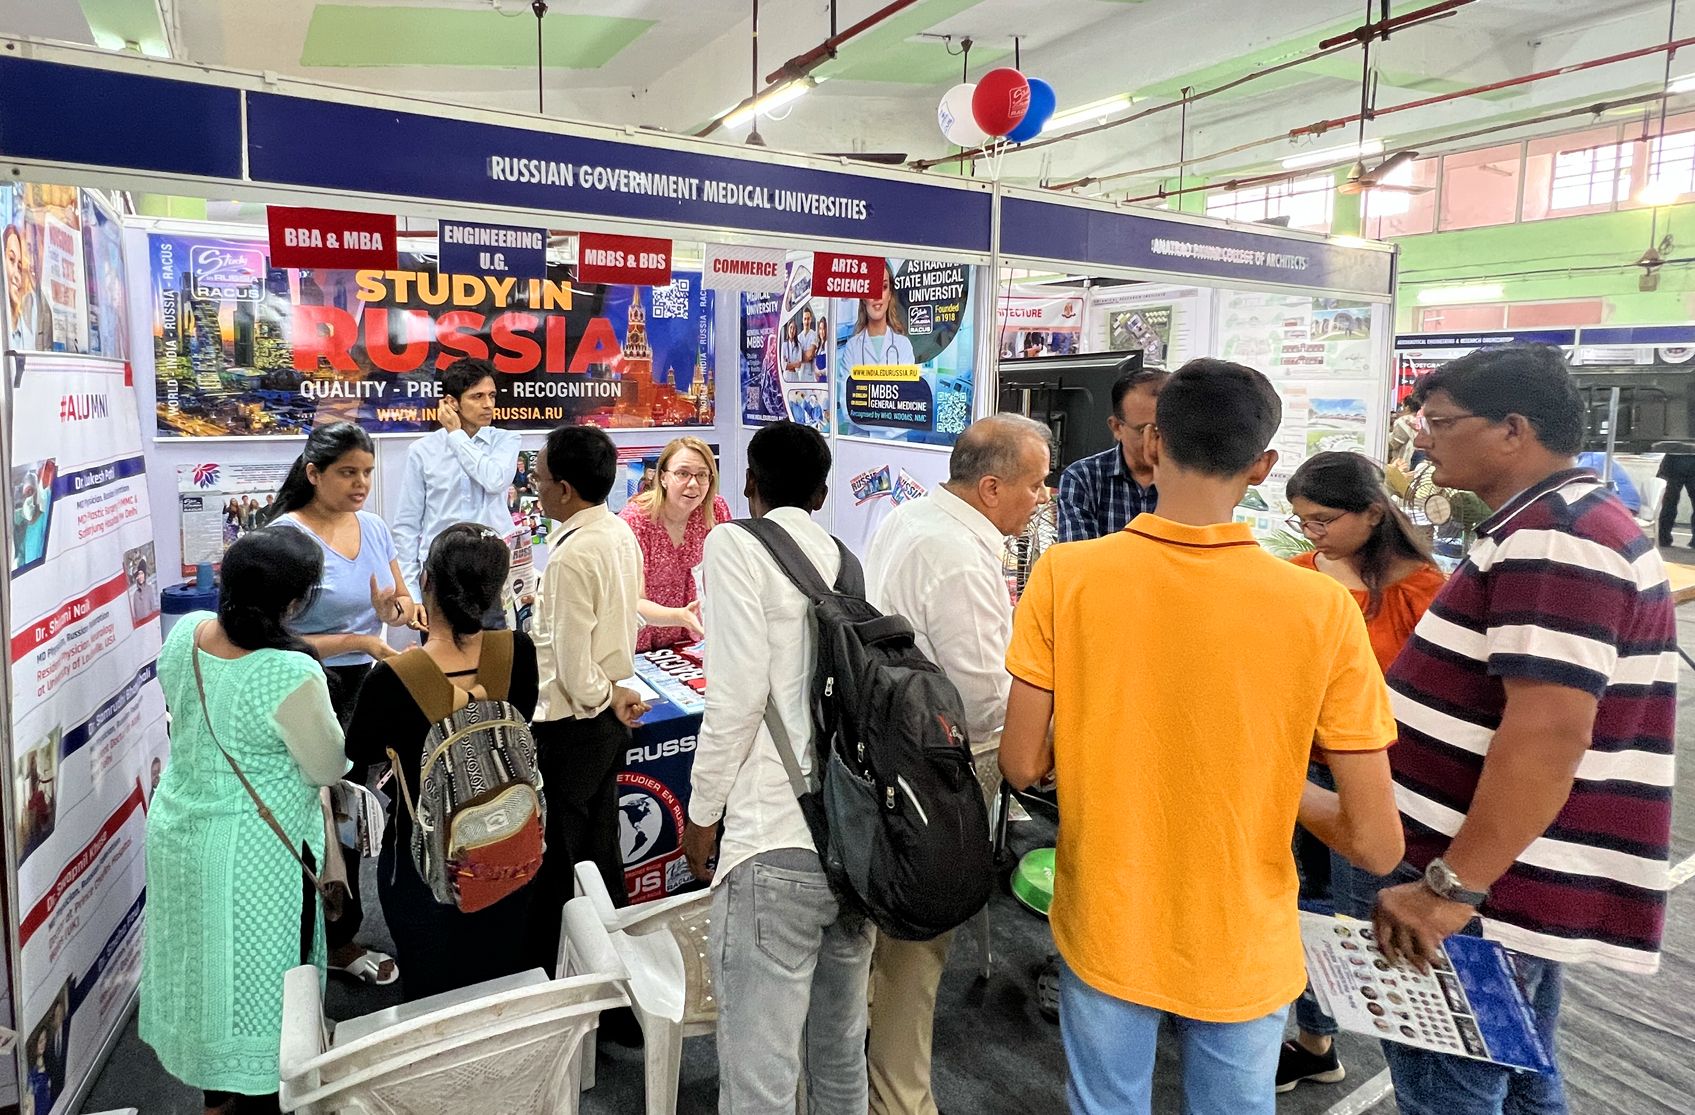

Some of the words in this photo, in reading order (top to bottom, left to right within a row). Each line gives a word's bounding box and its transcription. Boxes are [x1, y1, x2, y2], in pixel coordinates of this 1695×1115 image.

[491, 155, 574, 187] RUSSIAN
[579, 165, 699, 200] GOVERNMENT
[703, 180, 771, 209] MEDICAL
[775, 189, 867, 220] UNIVERSITIES
[284, 228, 323, 248] BBA
[326, 233, 340, 249] &
[343, 231, 383, 251] MBA
[444, 225, 542, 250] ENGINEERING
[161, 243, 173, 280] RACUS
[479, 252, 509, 271] U.G.
[584, 249, 625, 268] MBBS
[626, 254, 637, 269] &
[639, 253, 666, 270] BDS
[713, 258, 778, 277] COMMERCE
[831, 258, 859, 273] ARTS
[860, 262, 868, 274] &
[214, 274, 259, 283] RUSSIA
[826, 278, 870, 293] SCIENCE
[894, 275, 921, 290] STATE
[922, 268, 964, 286] MEDICAL
[197, 287, 260, 298] RACUS
[355, 269, 517, 308] STUDY
[529, 277, 573, 311] IN
[908, 284, 964, 303] UNIVERSITY
[163, 288, 176, 330] RUSSIA
[746, 301, 778, 316] UNIVERSITY
[935, 303, 959, 313] Founded
[941, 312, 956, 322] 1918
[293, 305, 627, 374] RUSSIA
[746, 335, 765, 349] MBBS
[166, 340, 178, 371] INDIA
[167, 379, 179, 417] WORLD
[300, 380, 387, 399] QUALITY
[513, 381, 622, 398] RECOGNITION
[871, 384, 899, 399] MBBS
[60, 393, 109, 423] #ALUMNI
[870, 400, 896, 410] GENERAL
[897, 401, 927, 412] MEDICINE
[35, 626, 48, 642] Dr.
[625, 735, 697, 766] RUSS
[616, 773, 660, 792] ETUDIER
[661, 789, 675, 805] EN
